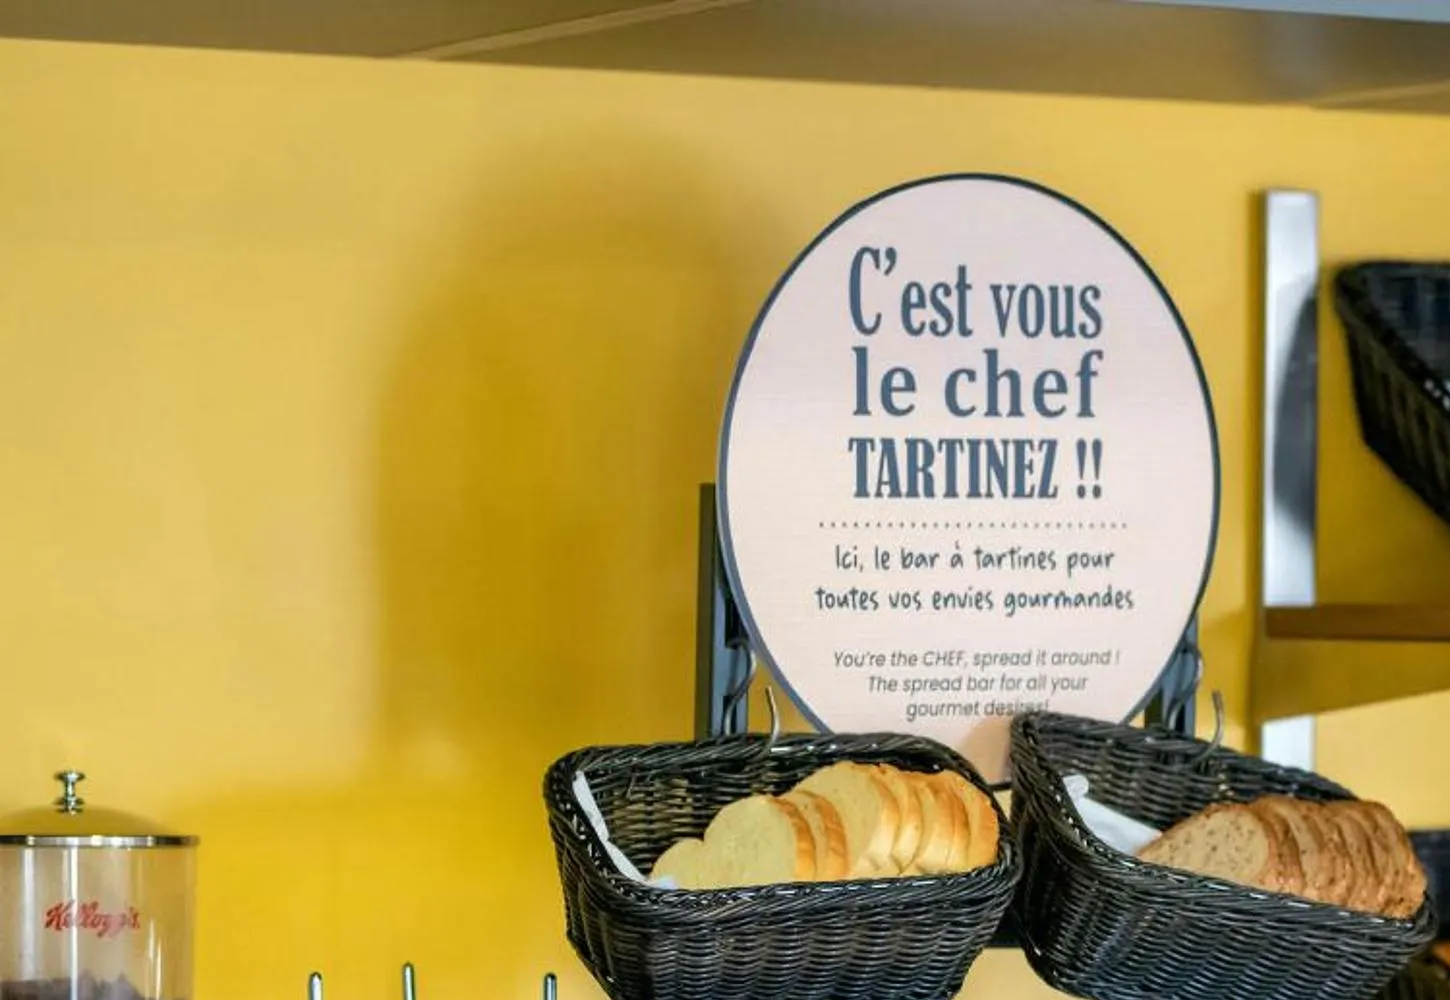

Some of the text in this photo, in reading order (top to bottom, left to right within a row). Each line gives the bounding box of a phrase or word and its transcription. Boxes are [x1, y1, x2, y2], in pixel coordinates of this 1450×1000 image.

[848, 246, 1103, 339] C'est vous
[852, 346, 1104, 418] le chef
[848, 437, 1102, 499] TARTINEZ !!
[835, 541, 1115, 579] Ici, le bar à tartines pour
[814, 584, 1135, 618] toutes vos envies gourmandes
[890, 650, 918, 667] the
[922, 650, 969, 670] CHEF,
[973, 650, 1032, 672] spread
[1036, 650, 1047, 666] it
[1051, 650, 1111, 666] around
[869, 673, 1089, 697] The spread bar for all your
[906, 700, 980, 723] gourmet
